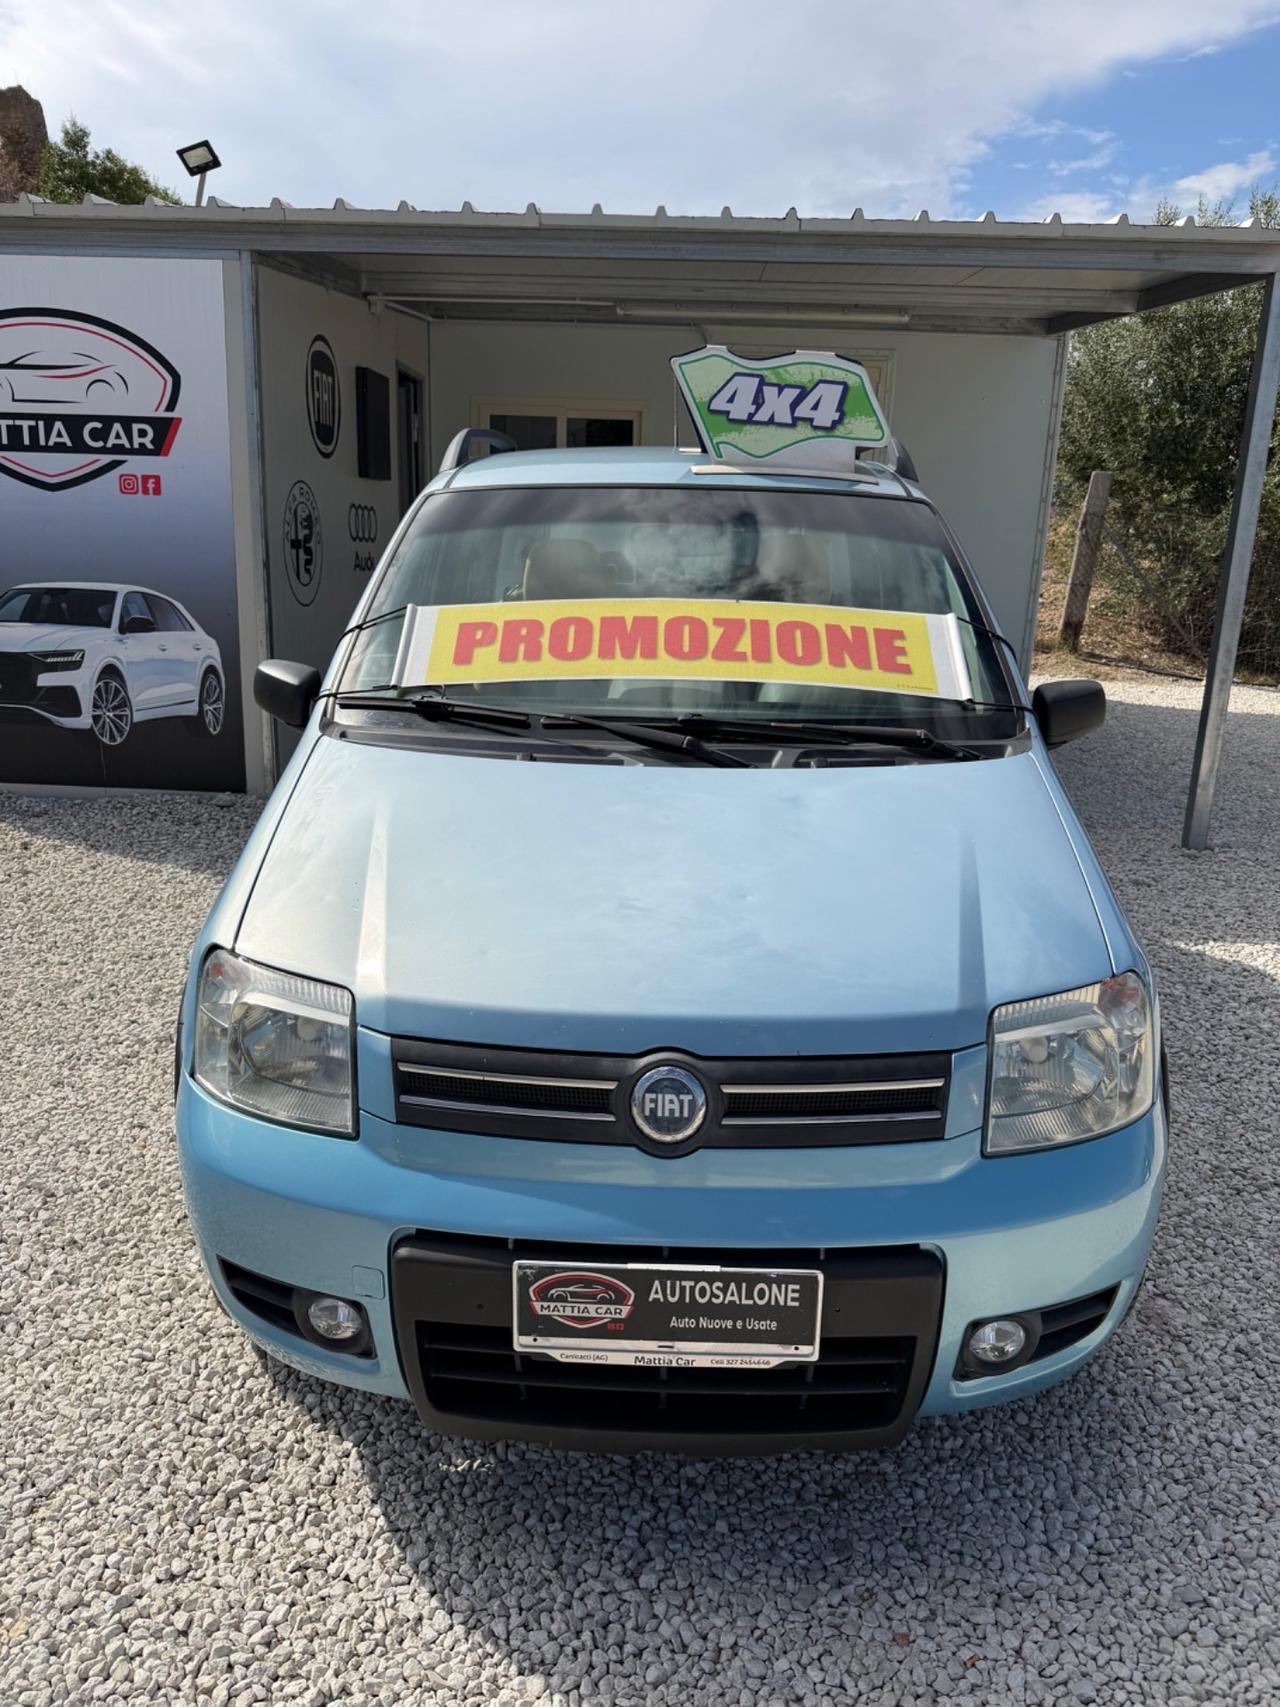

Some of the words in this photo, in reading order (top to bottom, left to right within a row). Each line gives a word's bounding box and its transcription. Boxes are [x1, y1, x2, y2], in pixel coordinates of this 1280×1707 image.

[313, 369, 333, 426] FIAT
[707, 373, 847, 429] 4x4
[82, 421, 155, 449] CAR
[452, 615, 913, 675] PROMOZIONE
[644, 1093, 693, 1118] FIAT
[648, 1280, 800, 1307] AUTOSALONE
[540, 1304, 591, 1315] MATTIA
[595, 1306, 623, 1316] CAR
[669, 1316, 696, 1328] Auto
[699, 1316, 733, 1329] Nuove
[736, 1320, 743, 1329] e
[745, 1318, 777, 1331] Usate
[633, 1355, 673, 1366] Mattia
[675, 1357, 696, 1366] Car
